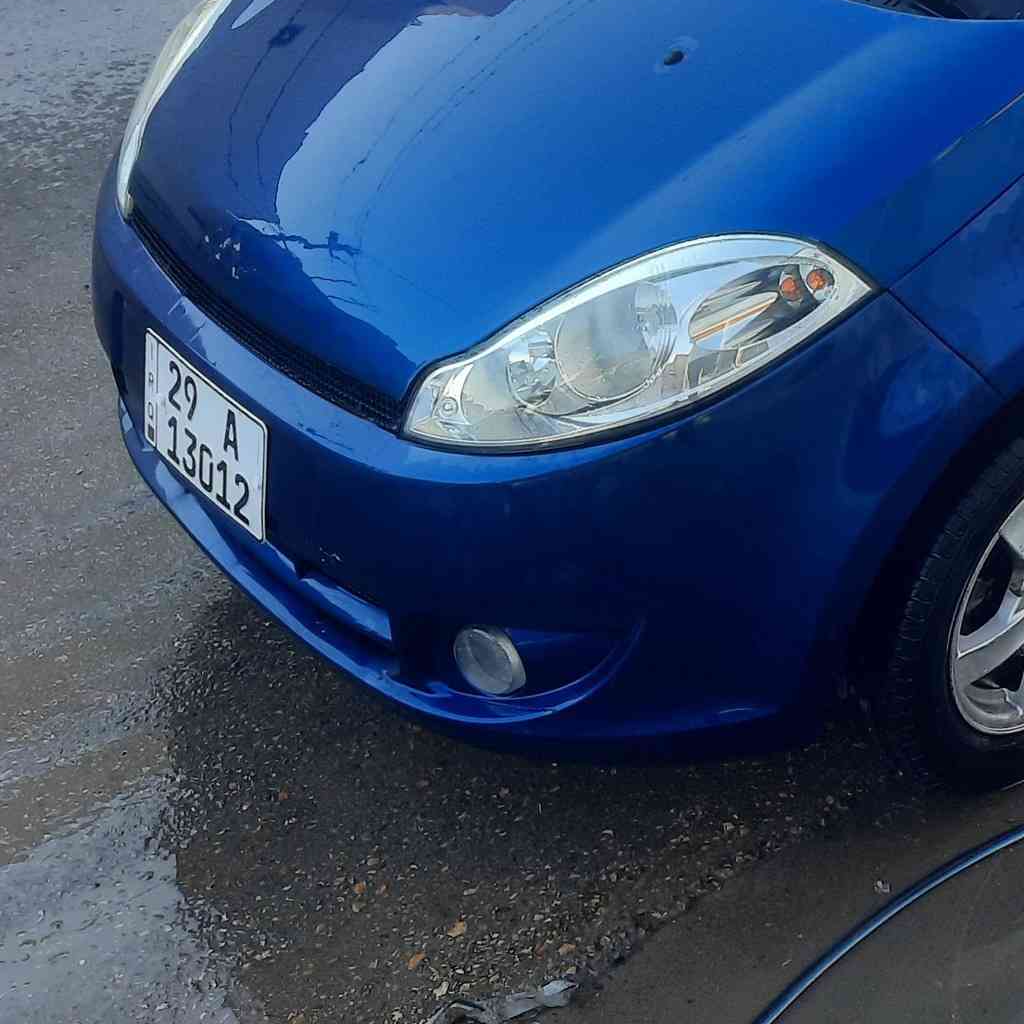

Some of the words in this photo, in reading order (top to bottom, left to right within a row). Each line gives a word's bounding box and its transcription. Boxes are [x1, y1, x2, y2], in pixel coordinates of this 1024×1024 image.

[168, 361, 197, 421] 29
[224, 408, 240, 462] A
[167, 415, 250, 526] 13012
